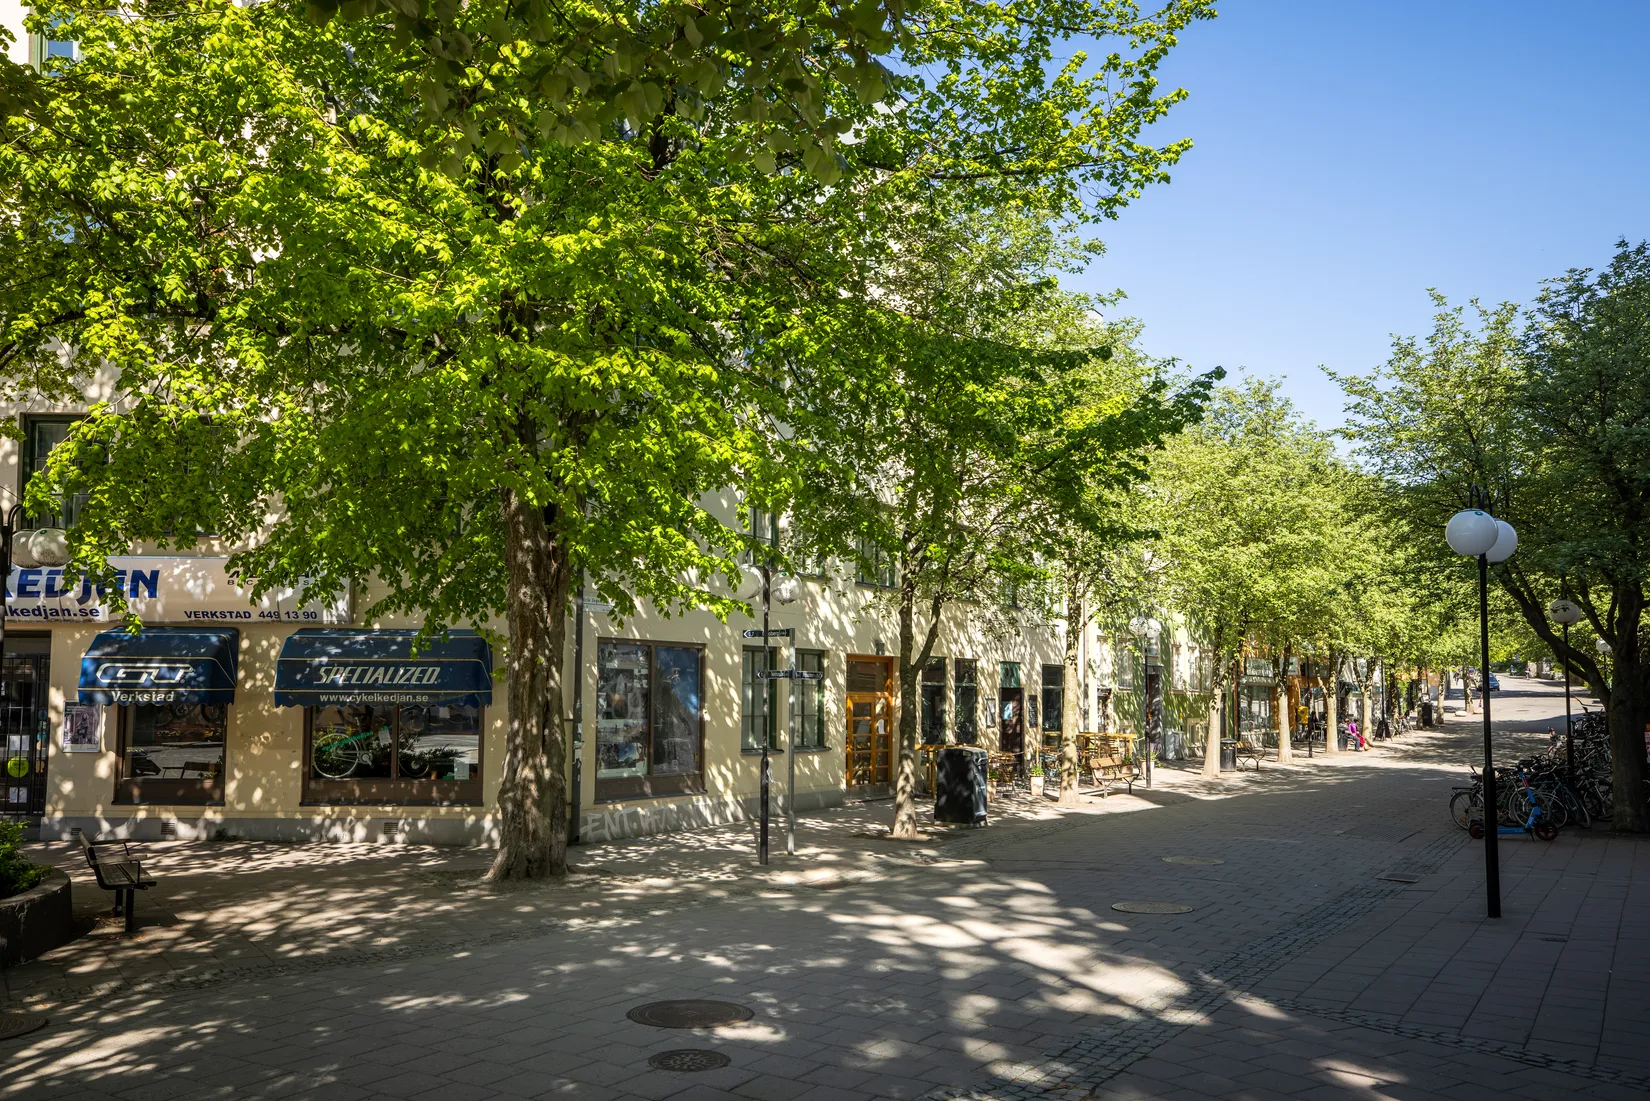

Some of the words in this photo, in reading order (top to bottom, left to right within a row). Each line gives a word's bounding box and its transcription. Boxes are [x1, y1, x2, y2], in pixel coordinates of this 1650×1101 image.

[184, 610, 252, 619] VERKSTAD
[258, 610, 280, 619] 449
[285, 610, 299, 619] 13
[303, 610, 317, 619] 90
[313, 666, 441, 684] SPECIALIZED
[111, 691, 175, 702] Verkstad
[320, 693, 429, 704] www.cykelkedjan.se
